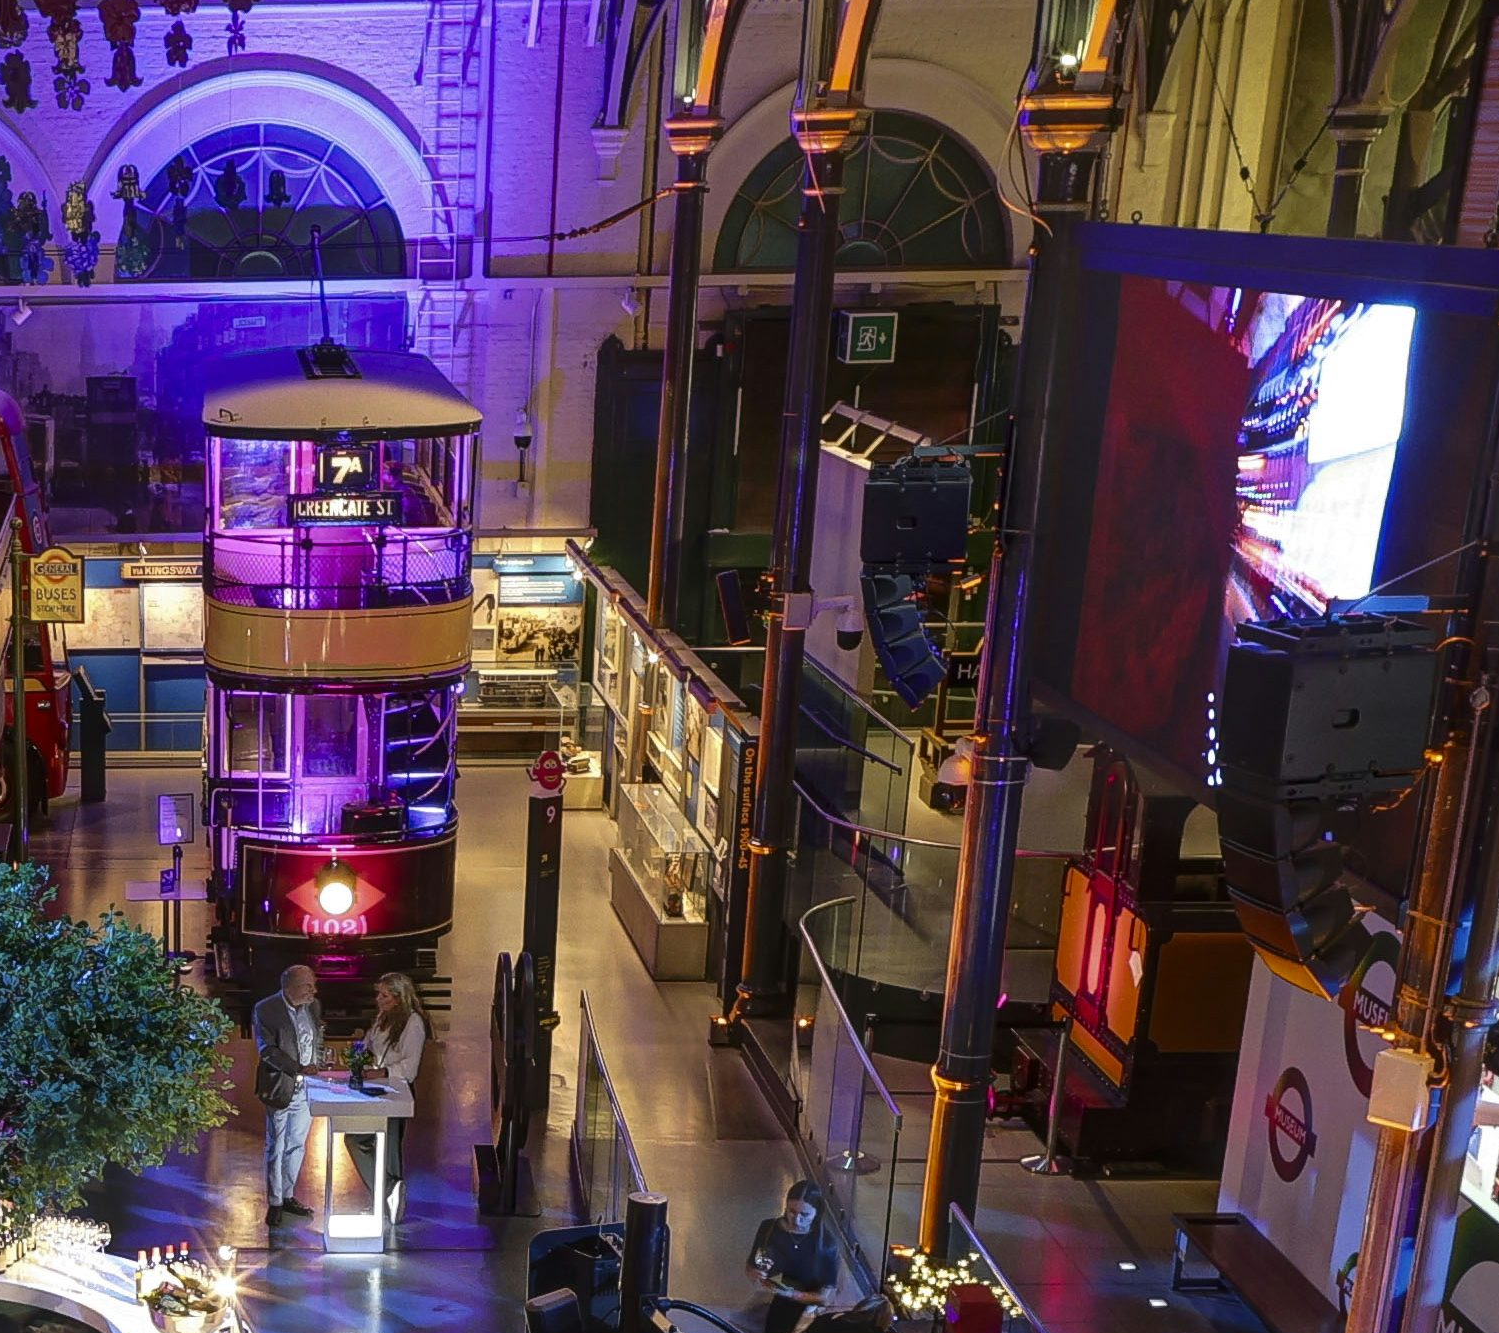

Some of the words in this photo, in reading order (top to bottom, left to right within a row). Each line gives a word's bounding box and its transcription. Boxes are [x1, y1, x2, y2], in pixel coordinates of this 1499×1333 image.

[331, 455, 363, 485] 7A
[297, 498, 372, 516] GREENGATE
[35, 562, 78, 576] GENERAL
[145, 565, 201, 576] KINGSWAY
[36, 588, 77, 601] BUSES
[747, 747, 756, 764] On
[746, 766, 754, 783] the
[741, 785, 753, 825] surface
[546, 805, 556, 824] 9
[1275, 1105, 1308, 1146] MUSEUM
